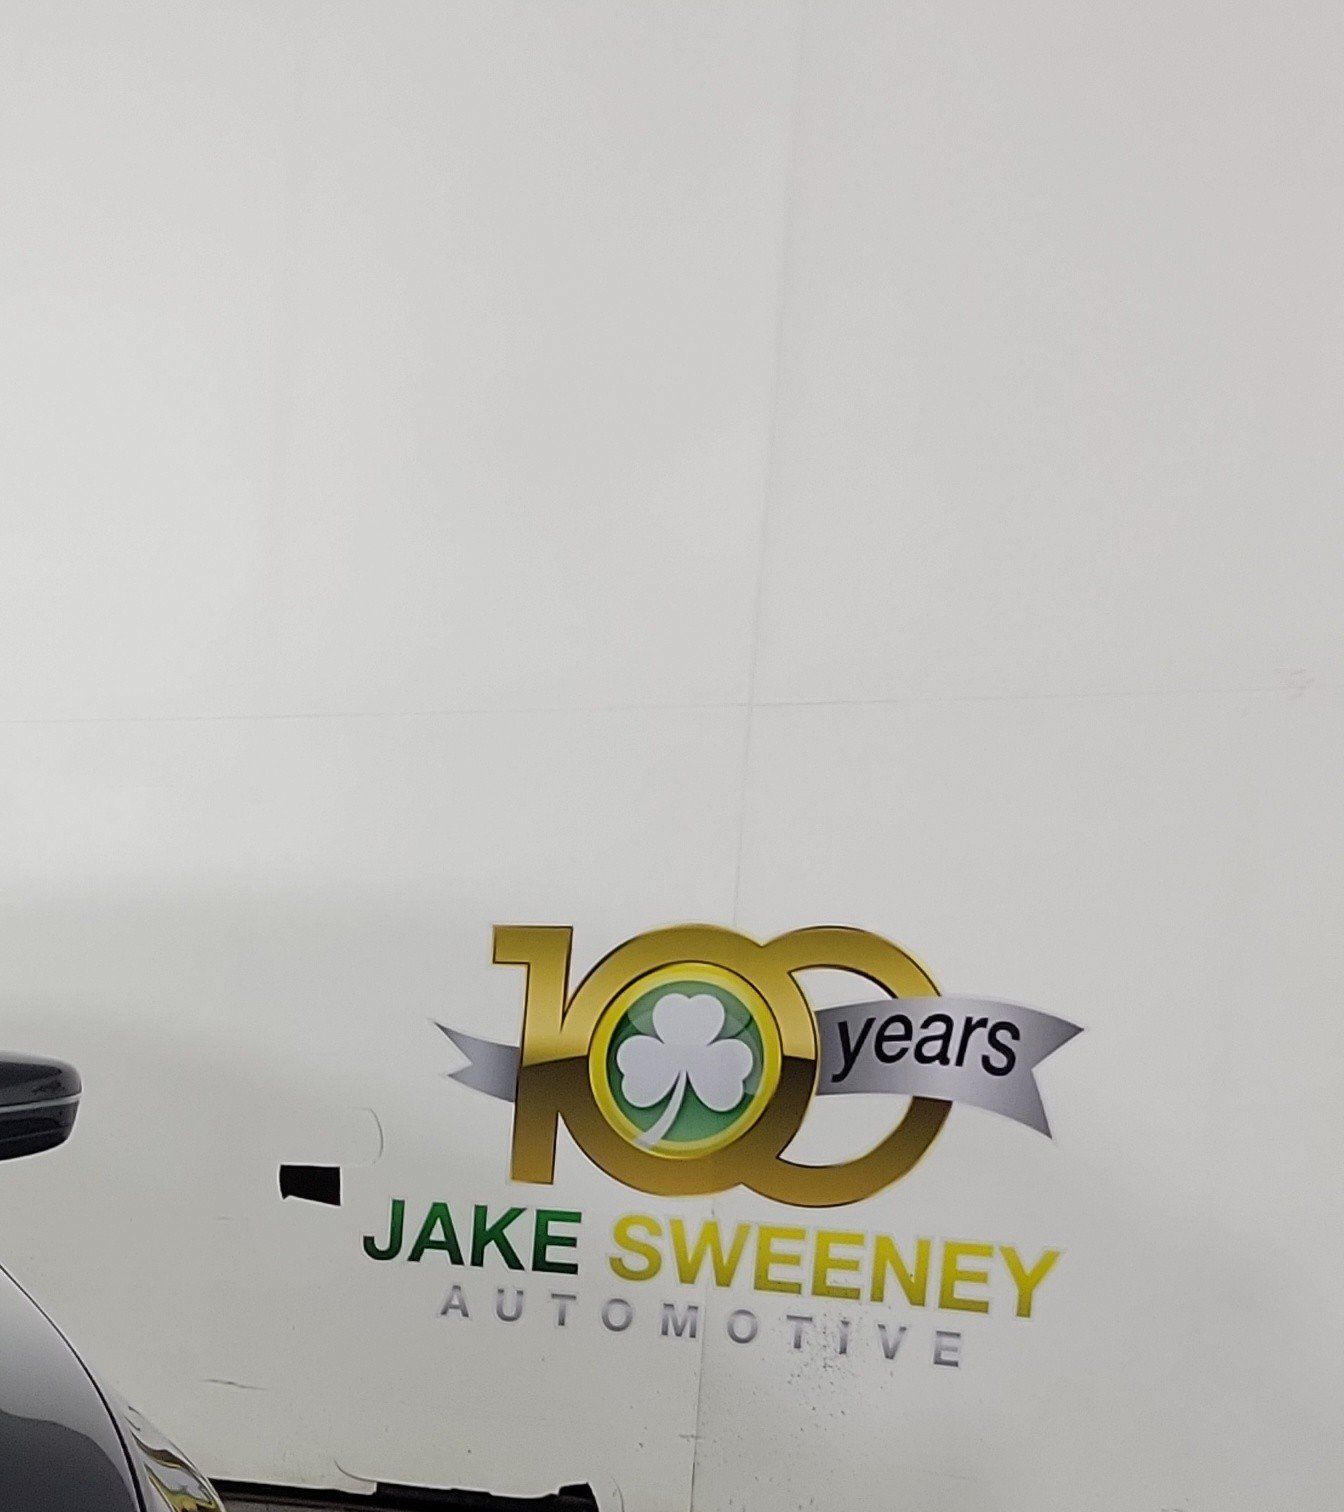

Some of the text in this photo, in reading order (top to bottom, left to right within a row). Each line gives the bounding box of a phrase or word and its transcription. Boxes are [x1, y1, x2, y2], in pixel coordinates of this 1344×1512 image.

[492, 925, 1021, 1208] 100 years
[362, 1199, 1062, 1319] JAKE SWEENEY
[439, 1284, 962, 1368] AUTOMOTIVE
